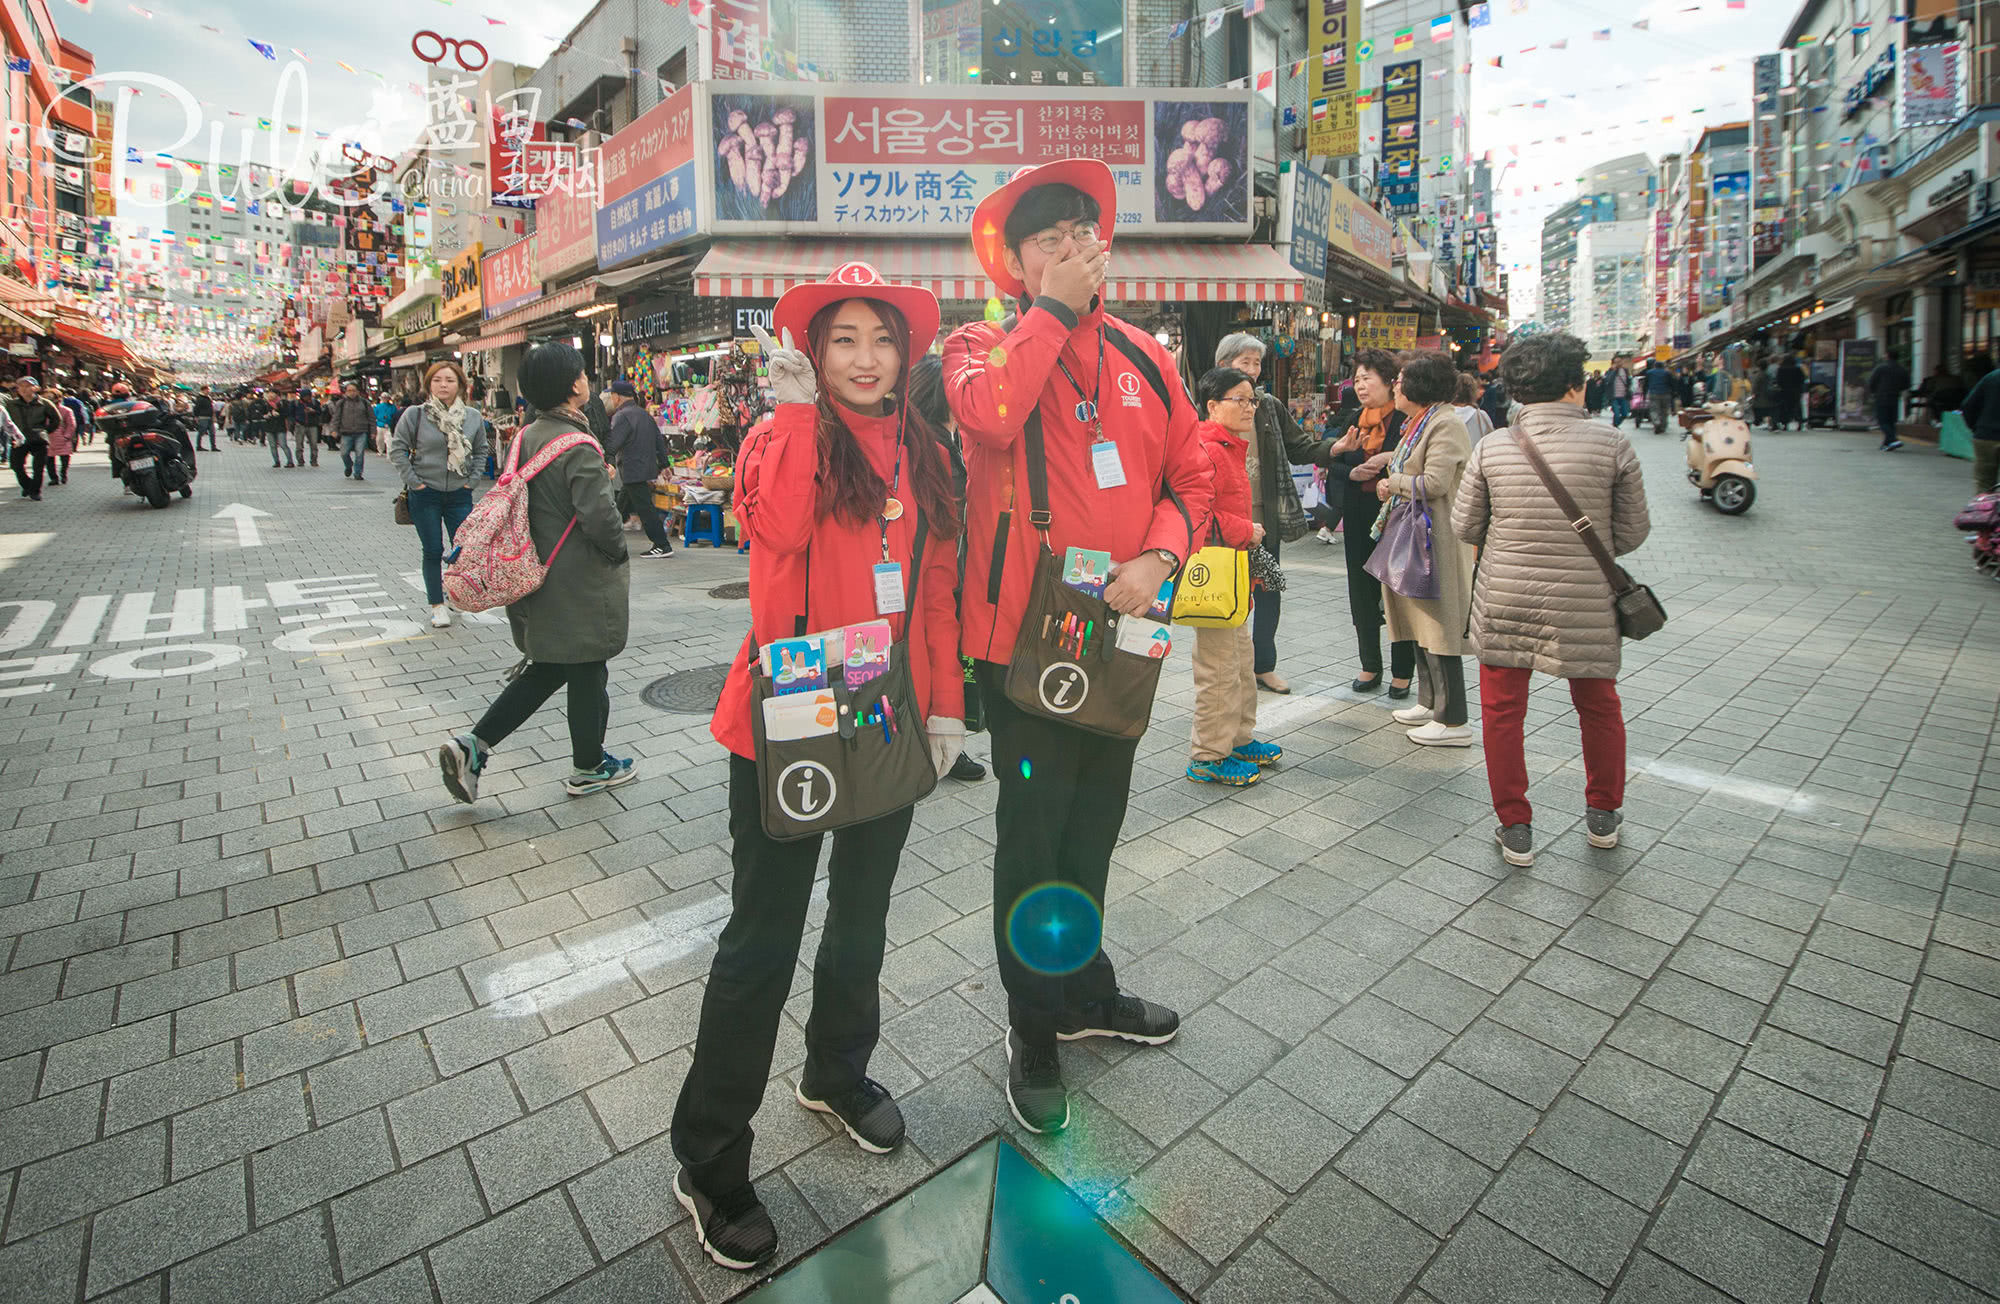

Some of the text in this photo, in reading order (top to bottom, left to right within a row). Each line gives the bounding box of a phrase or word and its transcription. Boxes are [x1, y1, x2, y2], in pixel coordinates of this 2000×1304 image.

[1031, 70, 1095, 85] 콘택트
[1037, 105, 1106, 122] 산지직송
[833, 106, 1024, 155] 서울상회
[1037, 123, 1140, 140] 자연송이버섯
[1037, 143, 1140, 159] 고려인삼도매
[1115, 170, 1142, 186] 門店
[834, 204, 975, 223] ディスカウント ストア
[1294, 169, 1332, 239] 동신안경
[630, 226, 648, 249] キムチ
[1295, 235, 1324, 271] 콘택트
[623, 317, 643, 343] ETOILE
[644, 311, 670, 338] COFFEE
